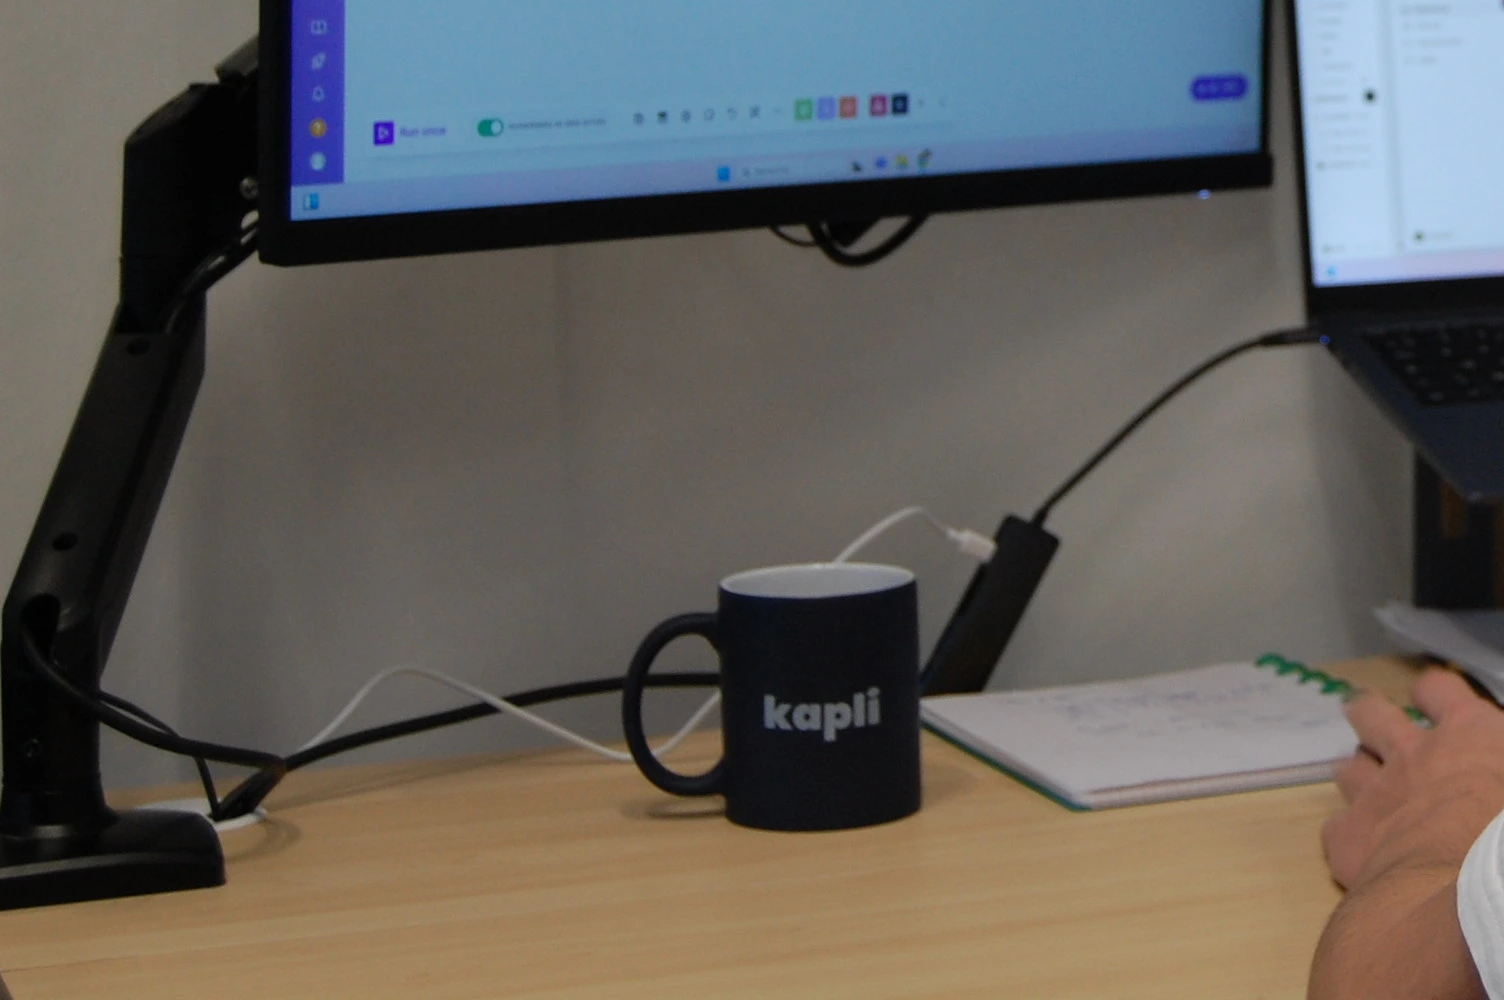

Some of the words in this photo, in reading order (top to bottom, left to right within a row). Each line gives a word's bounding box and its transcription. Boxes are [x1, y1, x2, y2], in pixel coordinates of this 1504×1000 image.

[400, 126, 419, 138] Run
[421, 126, 446, 137] once
[763, 687, 881, 742] kapli
